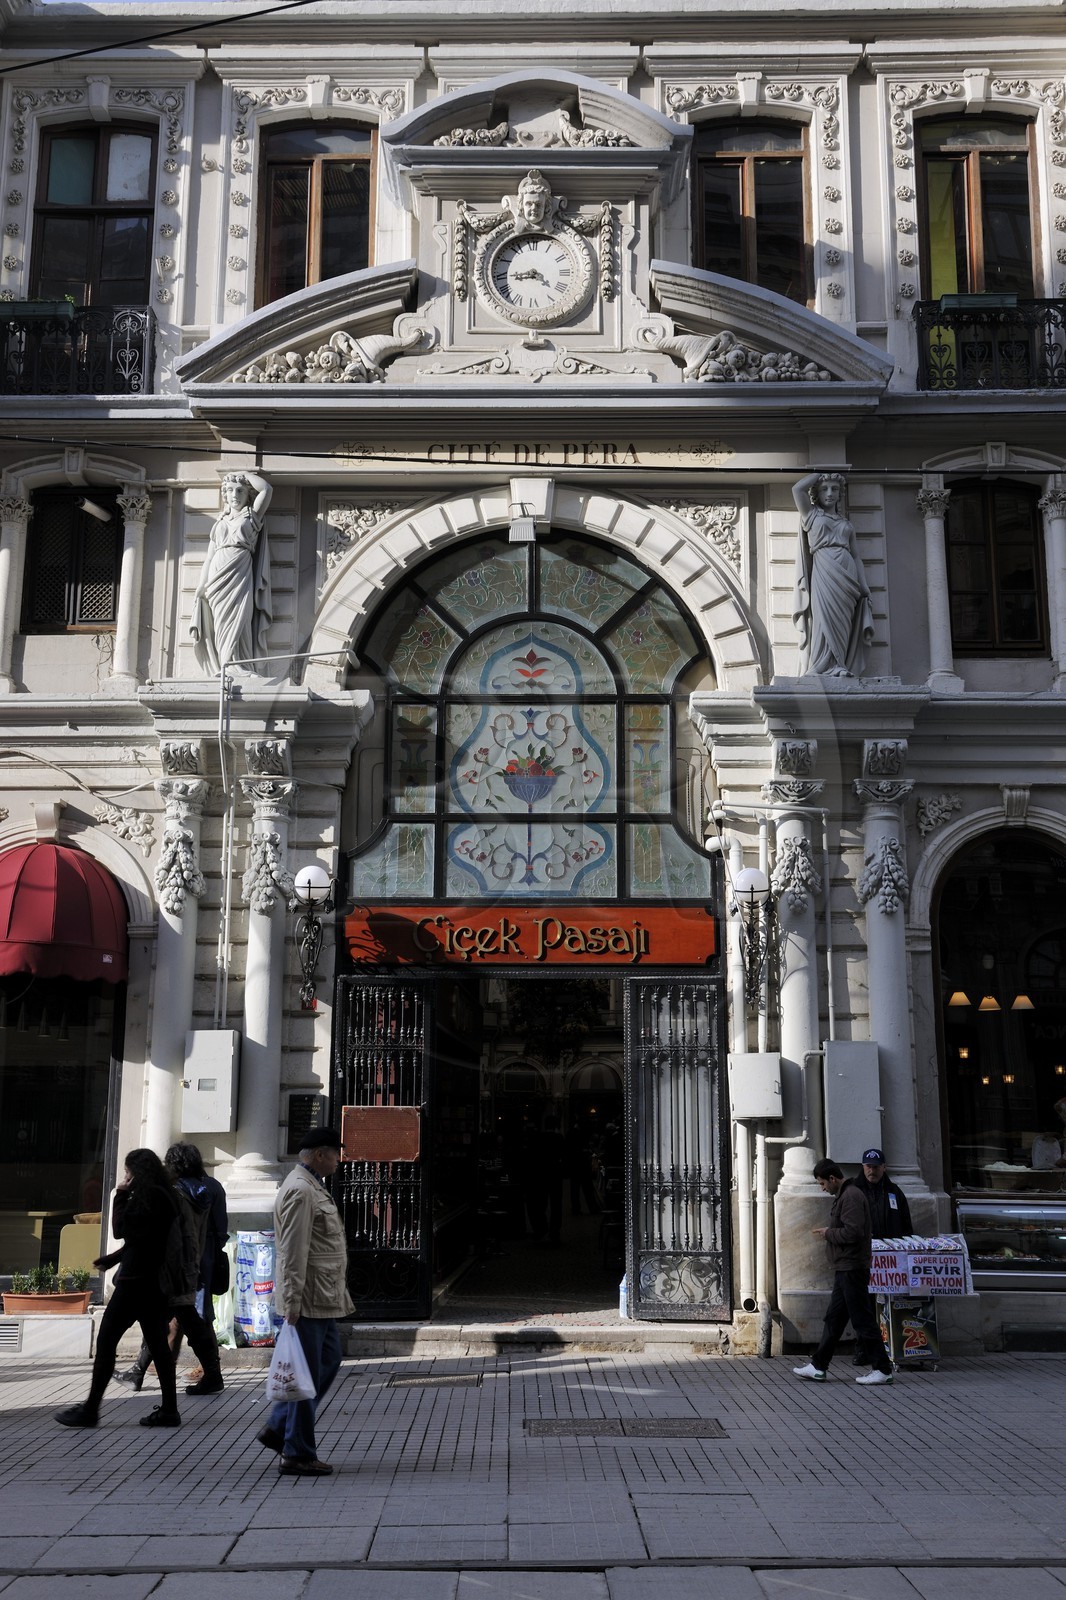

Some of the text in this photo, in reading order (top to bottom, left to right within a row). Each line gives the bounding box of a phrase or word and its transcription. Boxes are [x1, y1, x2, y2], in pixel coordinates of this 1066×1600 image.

[427, 441, 642, 465] CITÉ DE PÉRA
[413, 915, 520, 964] Çiçek
[912, 1264, 961, 1275] DEVİR
[920, 1275, 962, 1287] TRİLYON
[904, 1328, 928, 1348] 25
